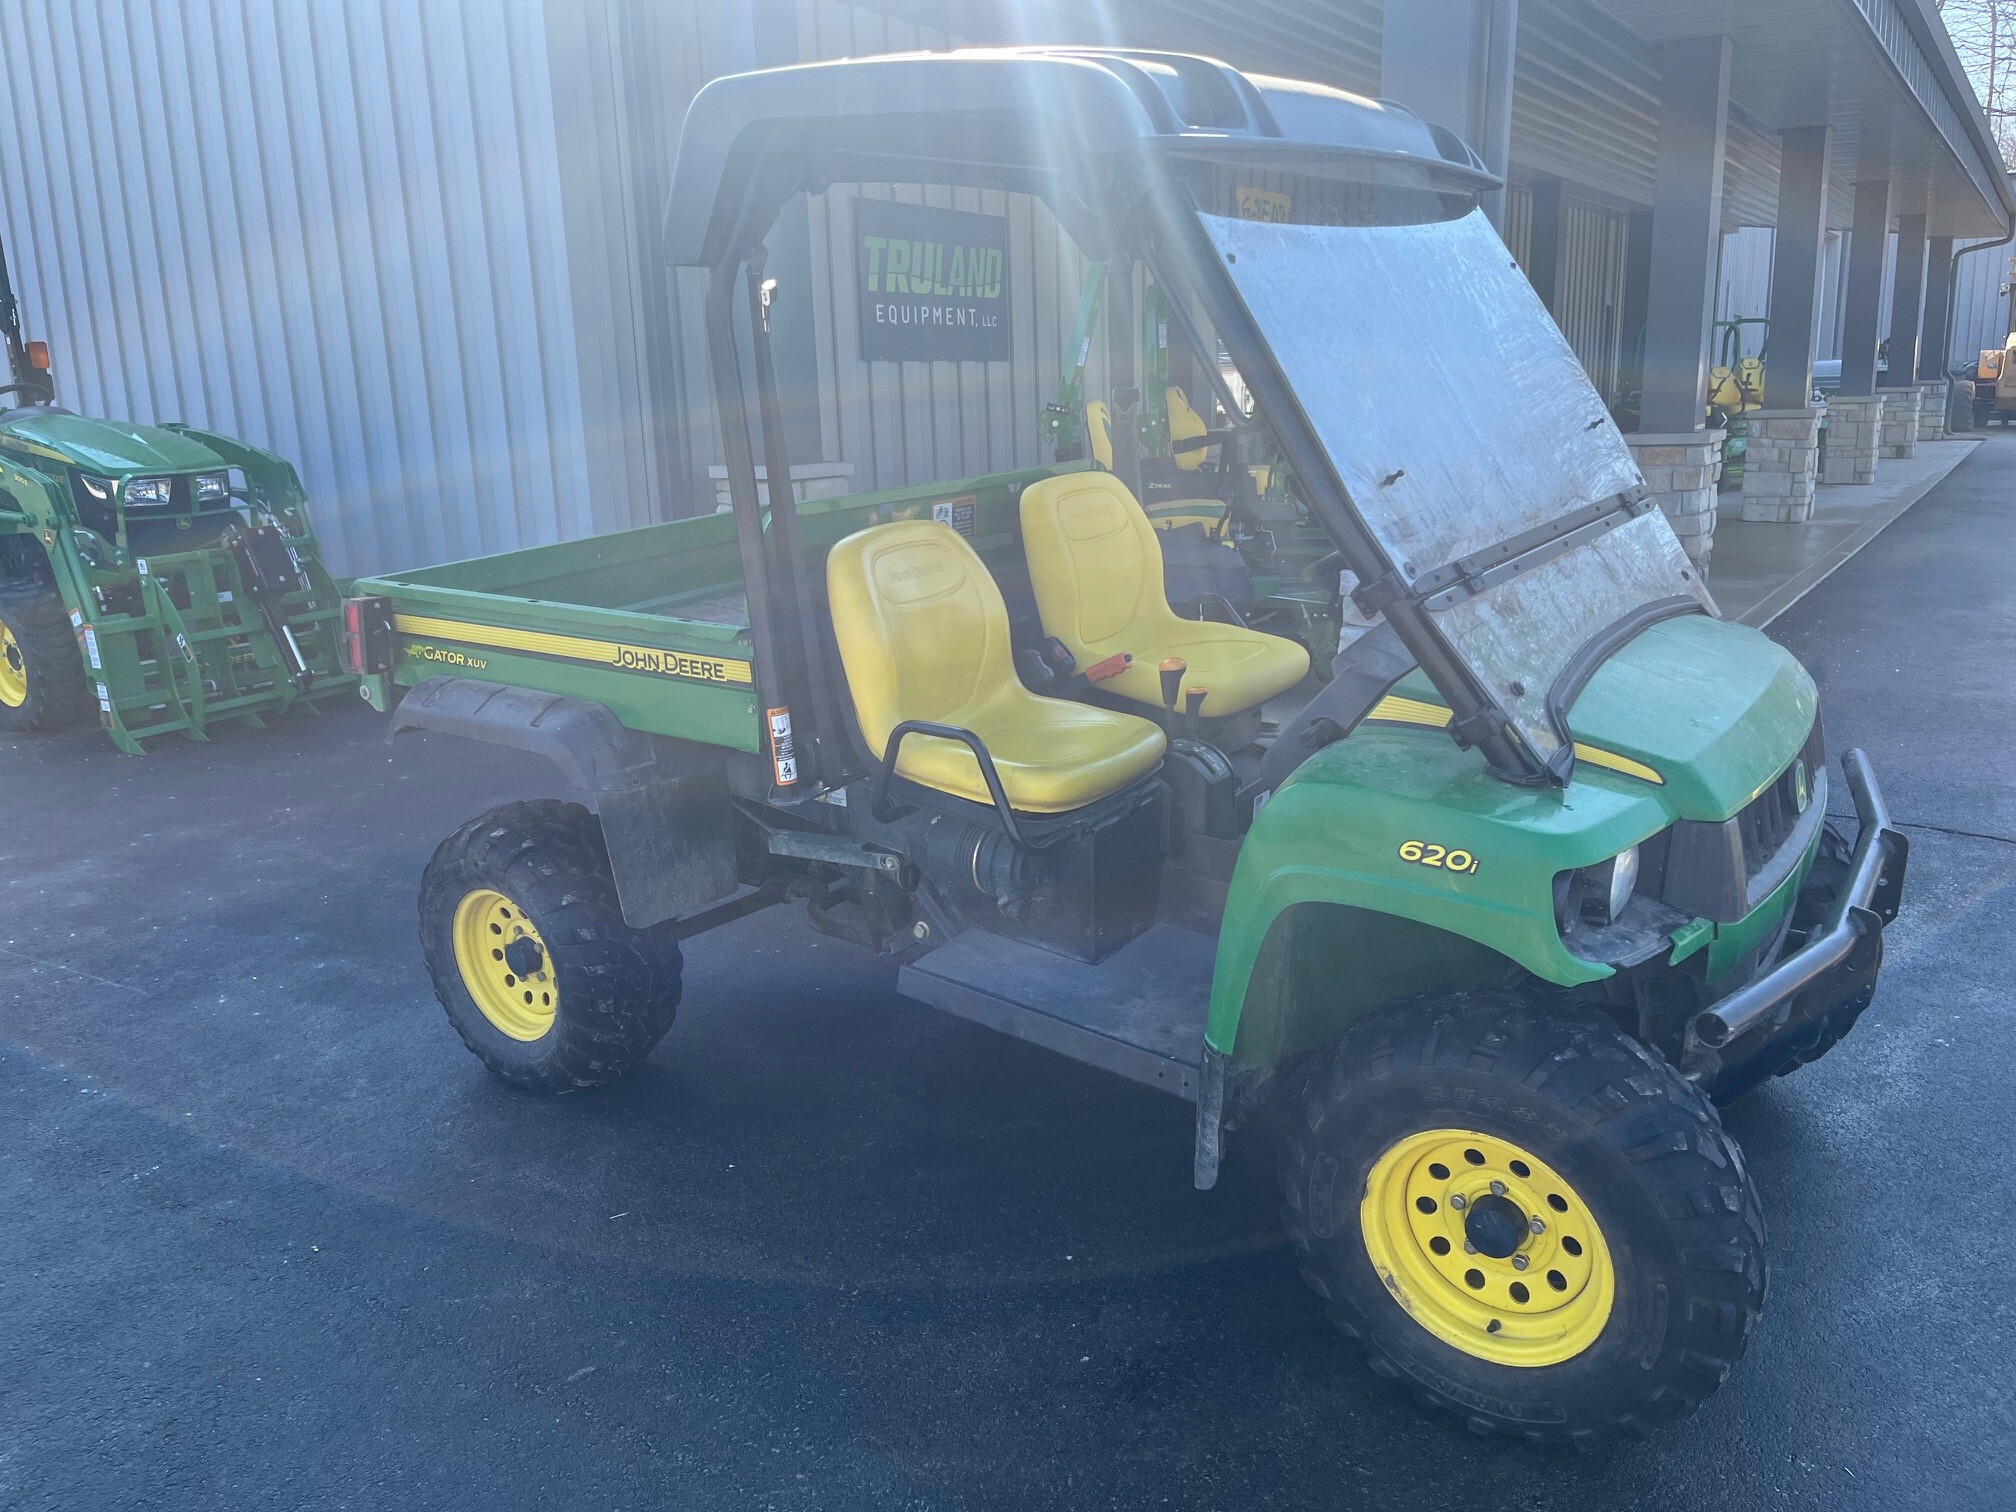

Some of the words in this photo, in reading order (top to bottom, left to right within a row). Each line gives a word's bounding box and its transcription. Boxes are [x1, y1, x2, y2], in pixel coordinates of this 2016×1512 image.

[864, 235, 1003, 299] TRULAND
[876, 304, 979, 328] EQUIPMENT,
[982, 315, 998, 327] LLC
[423, 645, 465, 666] GATOR
[466, 657, 488, 669] XUV
[612, 646, 660, 671] JOHN
[664, 652, 726, 681] DEERE
[1398, 840, 1479, 875] 620i
